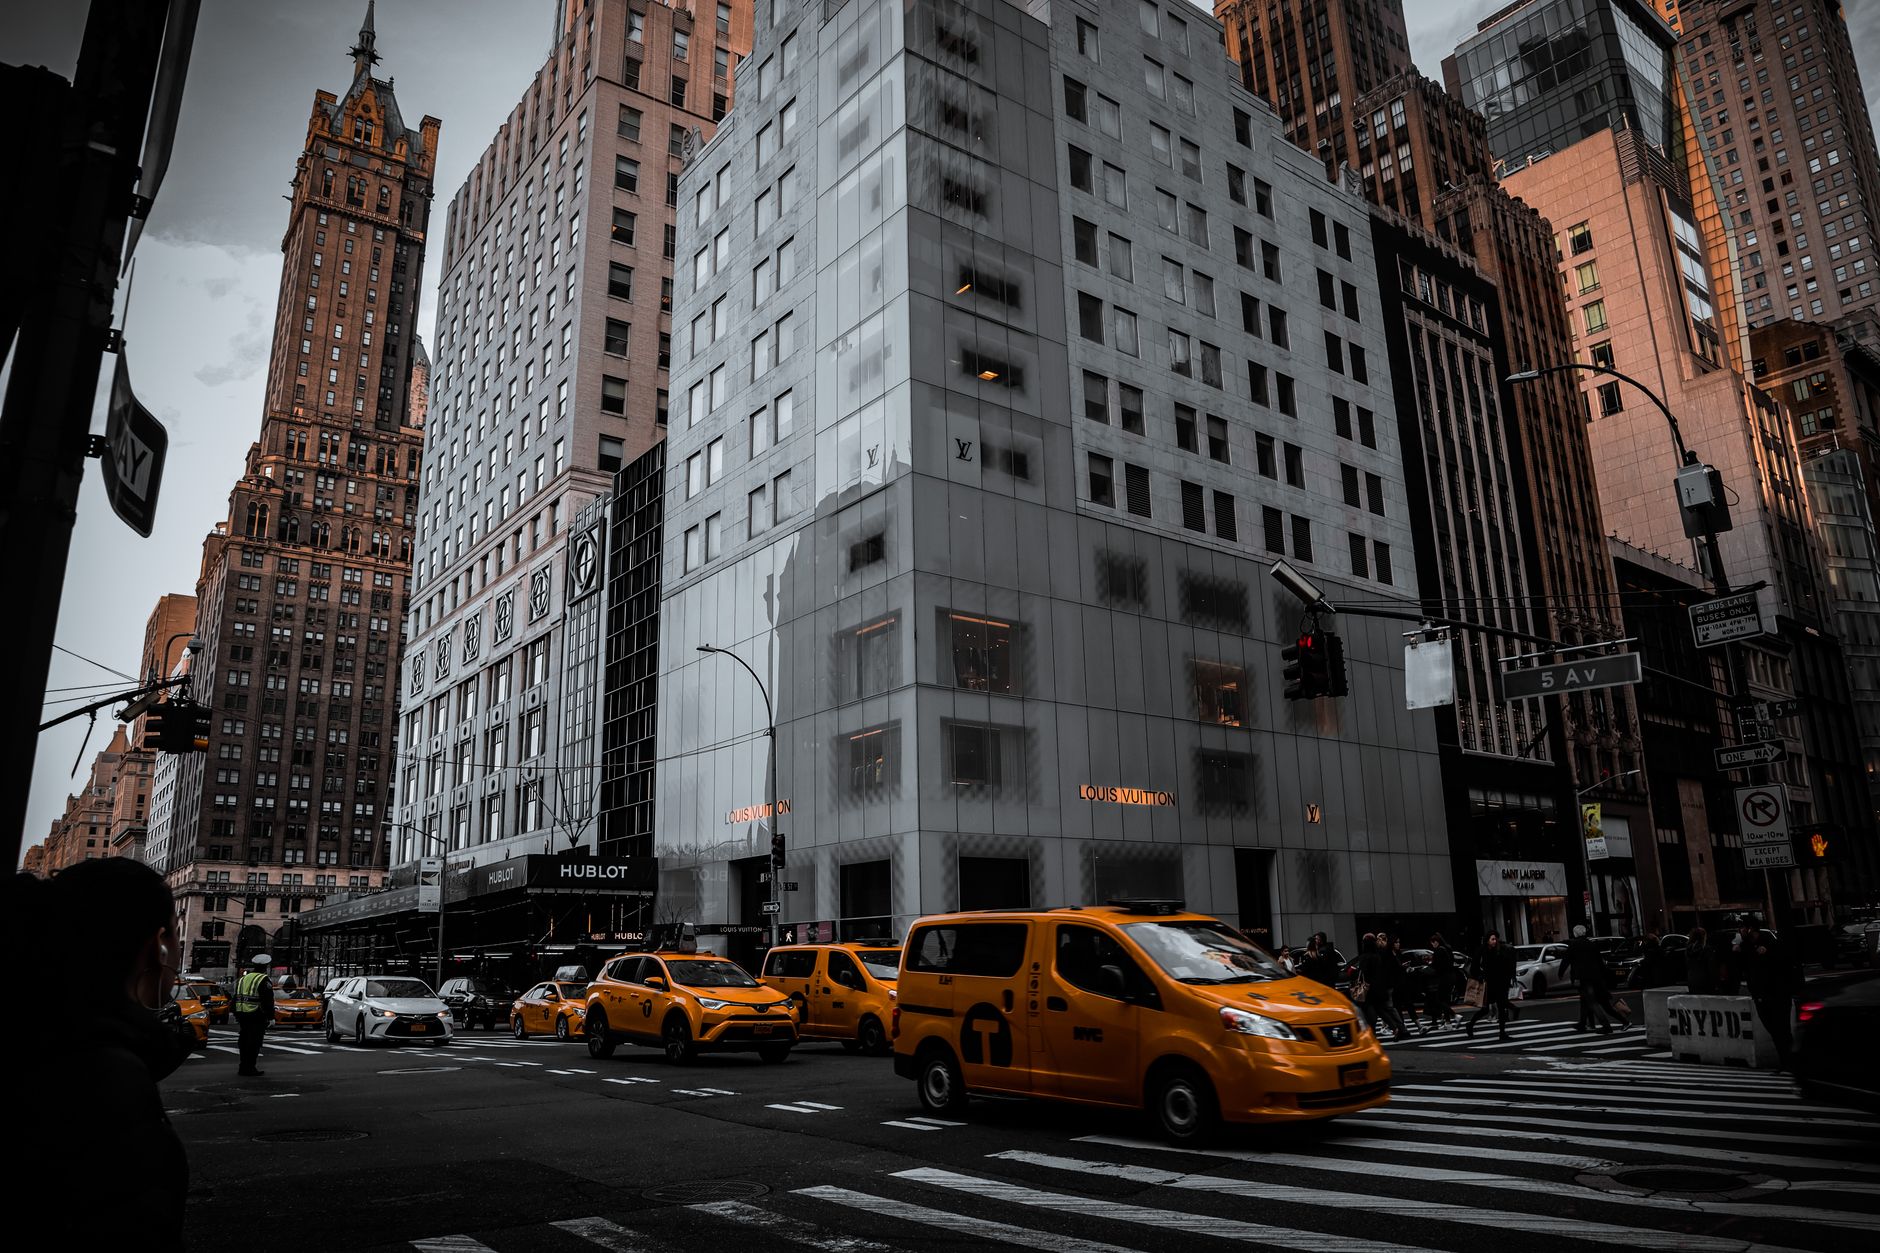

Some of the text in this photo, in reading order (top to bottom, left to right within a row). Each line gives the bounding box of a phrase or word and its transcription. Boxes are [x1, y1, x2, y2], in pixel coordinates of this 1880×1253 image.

[1708, 595, 1750, 611] BUS LANE
[1696, 604, 1753, 623] BUSES ONLY
[1541, 671, 1555, 689] 5
[1775, 703, 1784, 717] 5
[1725, 747, 1775, 763] ONE WAY
[1079, 785, 1176, 806] LOUIS VUITTON
[724, 799, 791, 825] LOUIS VUITON
[1754, 847, 1781, 856] EXCEPT
[1765, 856, 1789, 864] BUSES
[488, 867, 515, 885] HUBLOT
[560, 864, 629, 879] HUBLOT
[1502, 869, 1546, 880] SAINT LAURENT
[1516, 882, 1535, 890] PARIS
[614, 932, 644, 940] HUBLO
[720, 925, 763, 933] LOUIS VUITTON
[1677, 1009, 1741, 1039] NYPD
[1073, 1026, 1104, 1043] NYC
